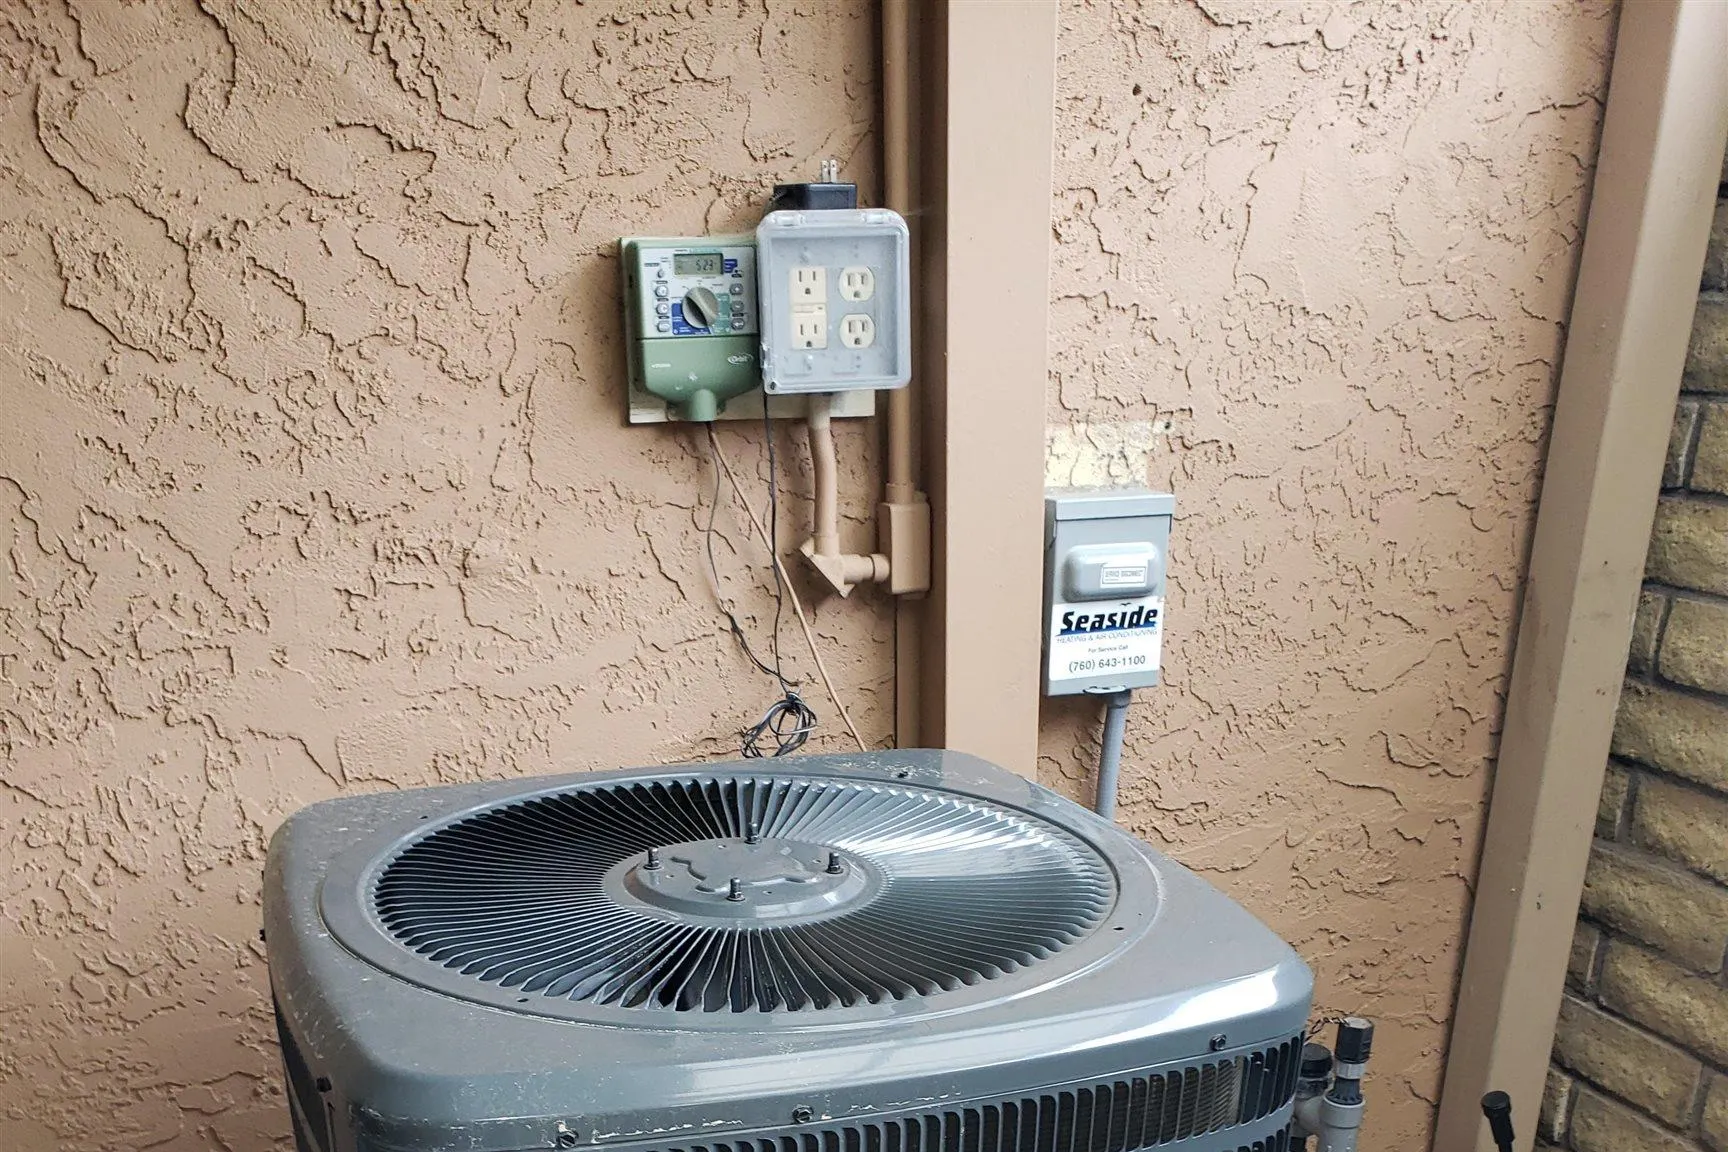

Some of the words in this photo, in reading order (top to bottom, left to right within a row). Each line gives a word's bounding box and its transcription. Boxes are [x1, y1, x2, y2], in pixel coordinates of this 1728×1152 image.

[1060, 605, 1158, 634] Seaside
[1069, 659, 1095, 673] (760)
[1098, 655, 1146, 668] 643-1100
